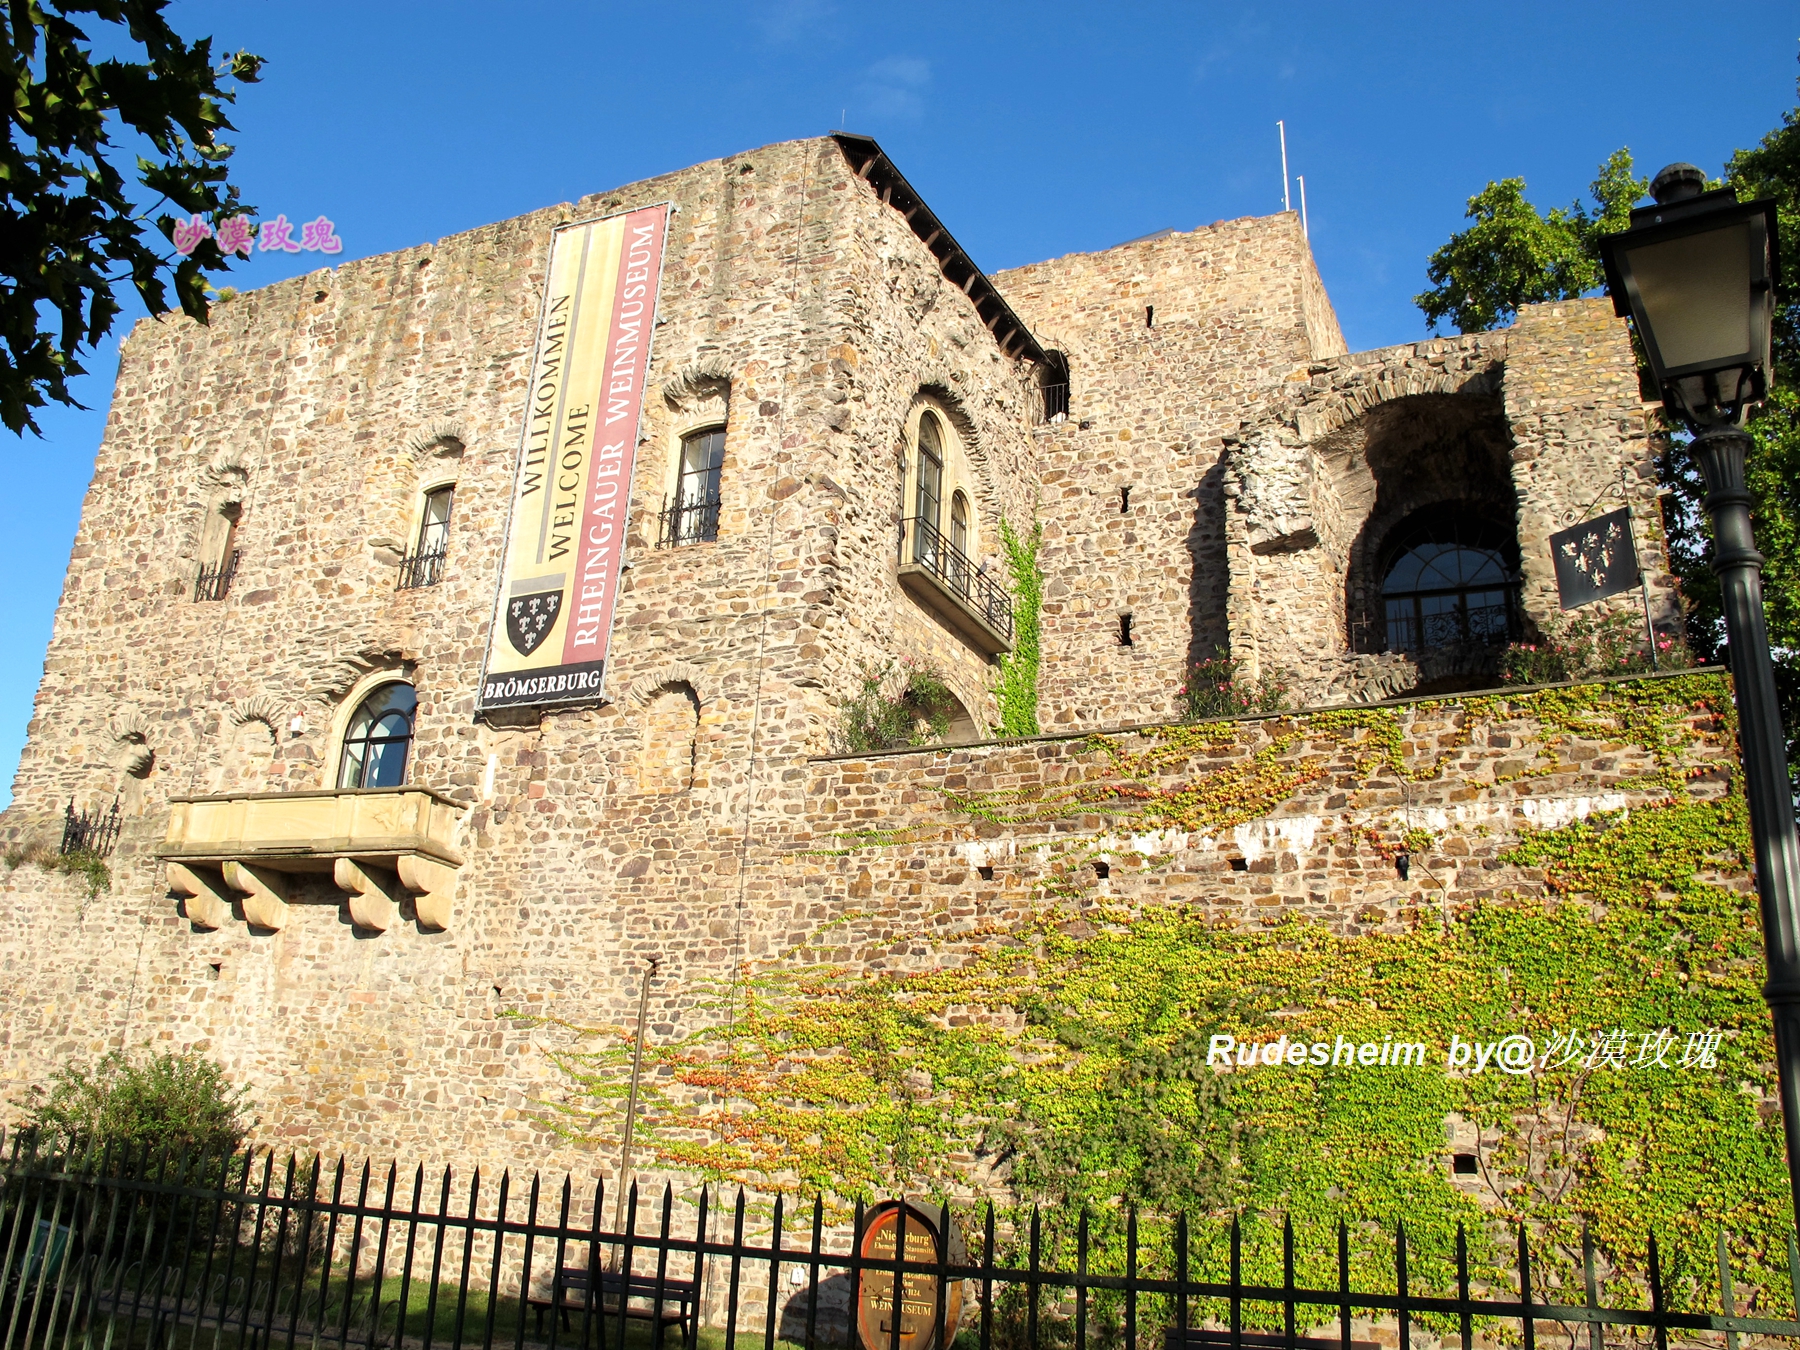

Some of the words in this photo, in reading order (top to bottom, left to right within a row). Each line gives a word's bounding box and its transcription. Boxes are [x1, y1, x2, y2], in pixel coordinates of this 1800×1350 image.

[522, 294, 570, 497] WILLKOMMEN
[573, 439, 625, 648] RHEINGAUER
[604, 222, 655, 426] WEINMUSEUM
[549, 403, 590, 562] WELCOME
[484, 670, 600, 699] BRÖMSERBURG
[903, 1253, 917, 1261] itter
[870, 1300, 931, 1316] WEINUSEUM
